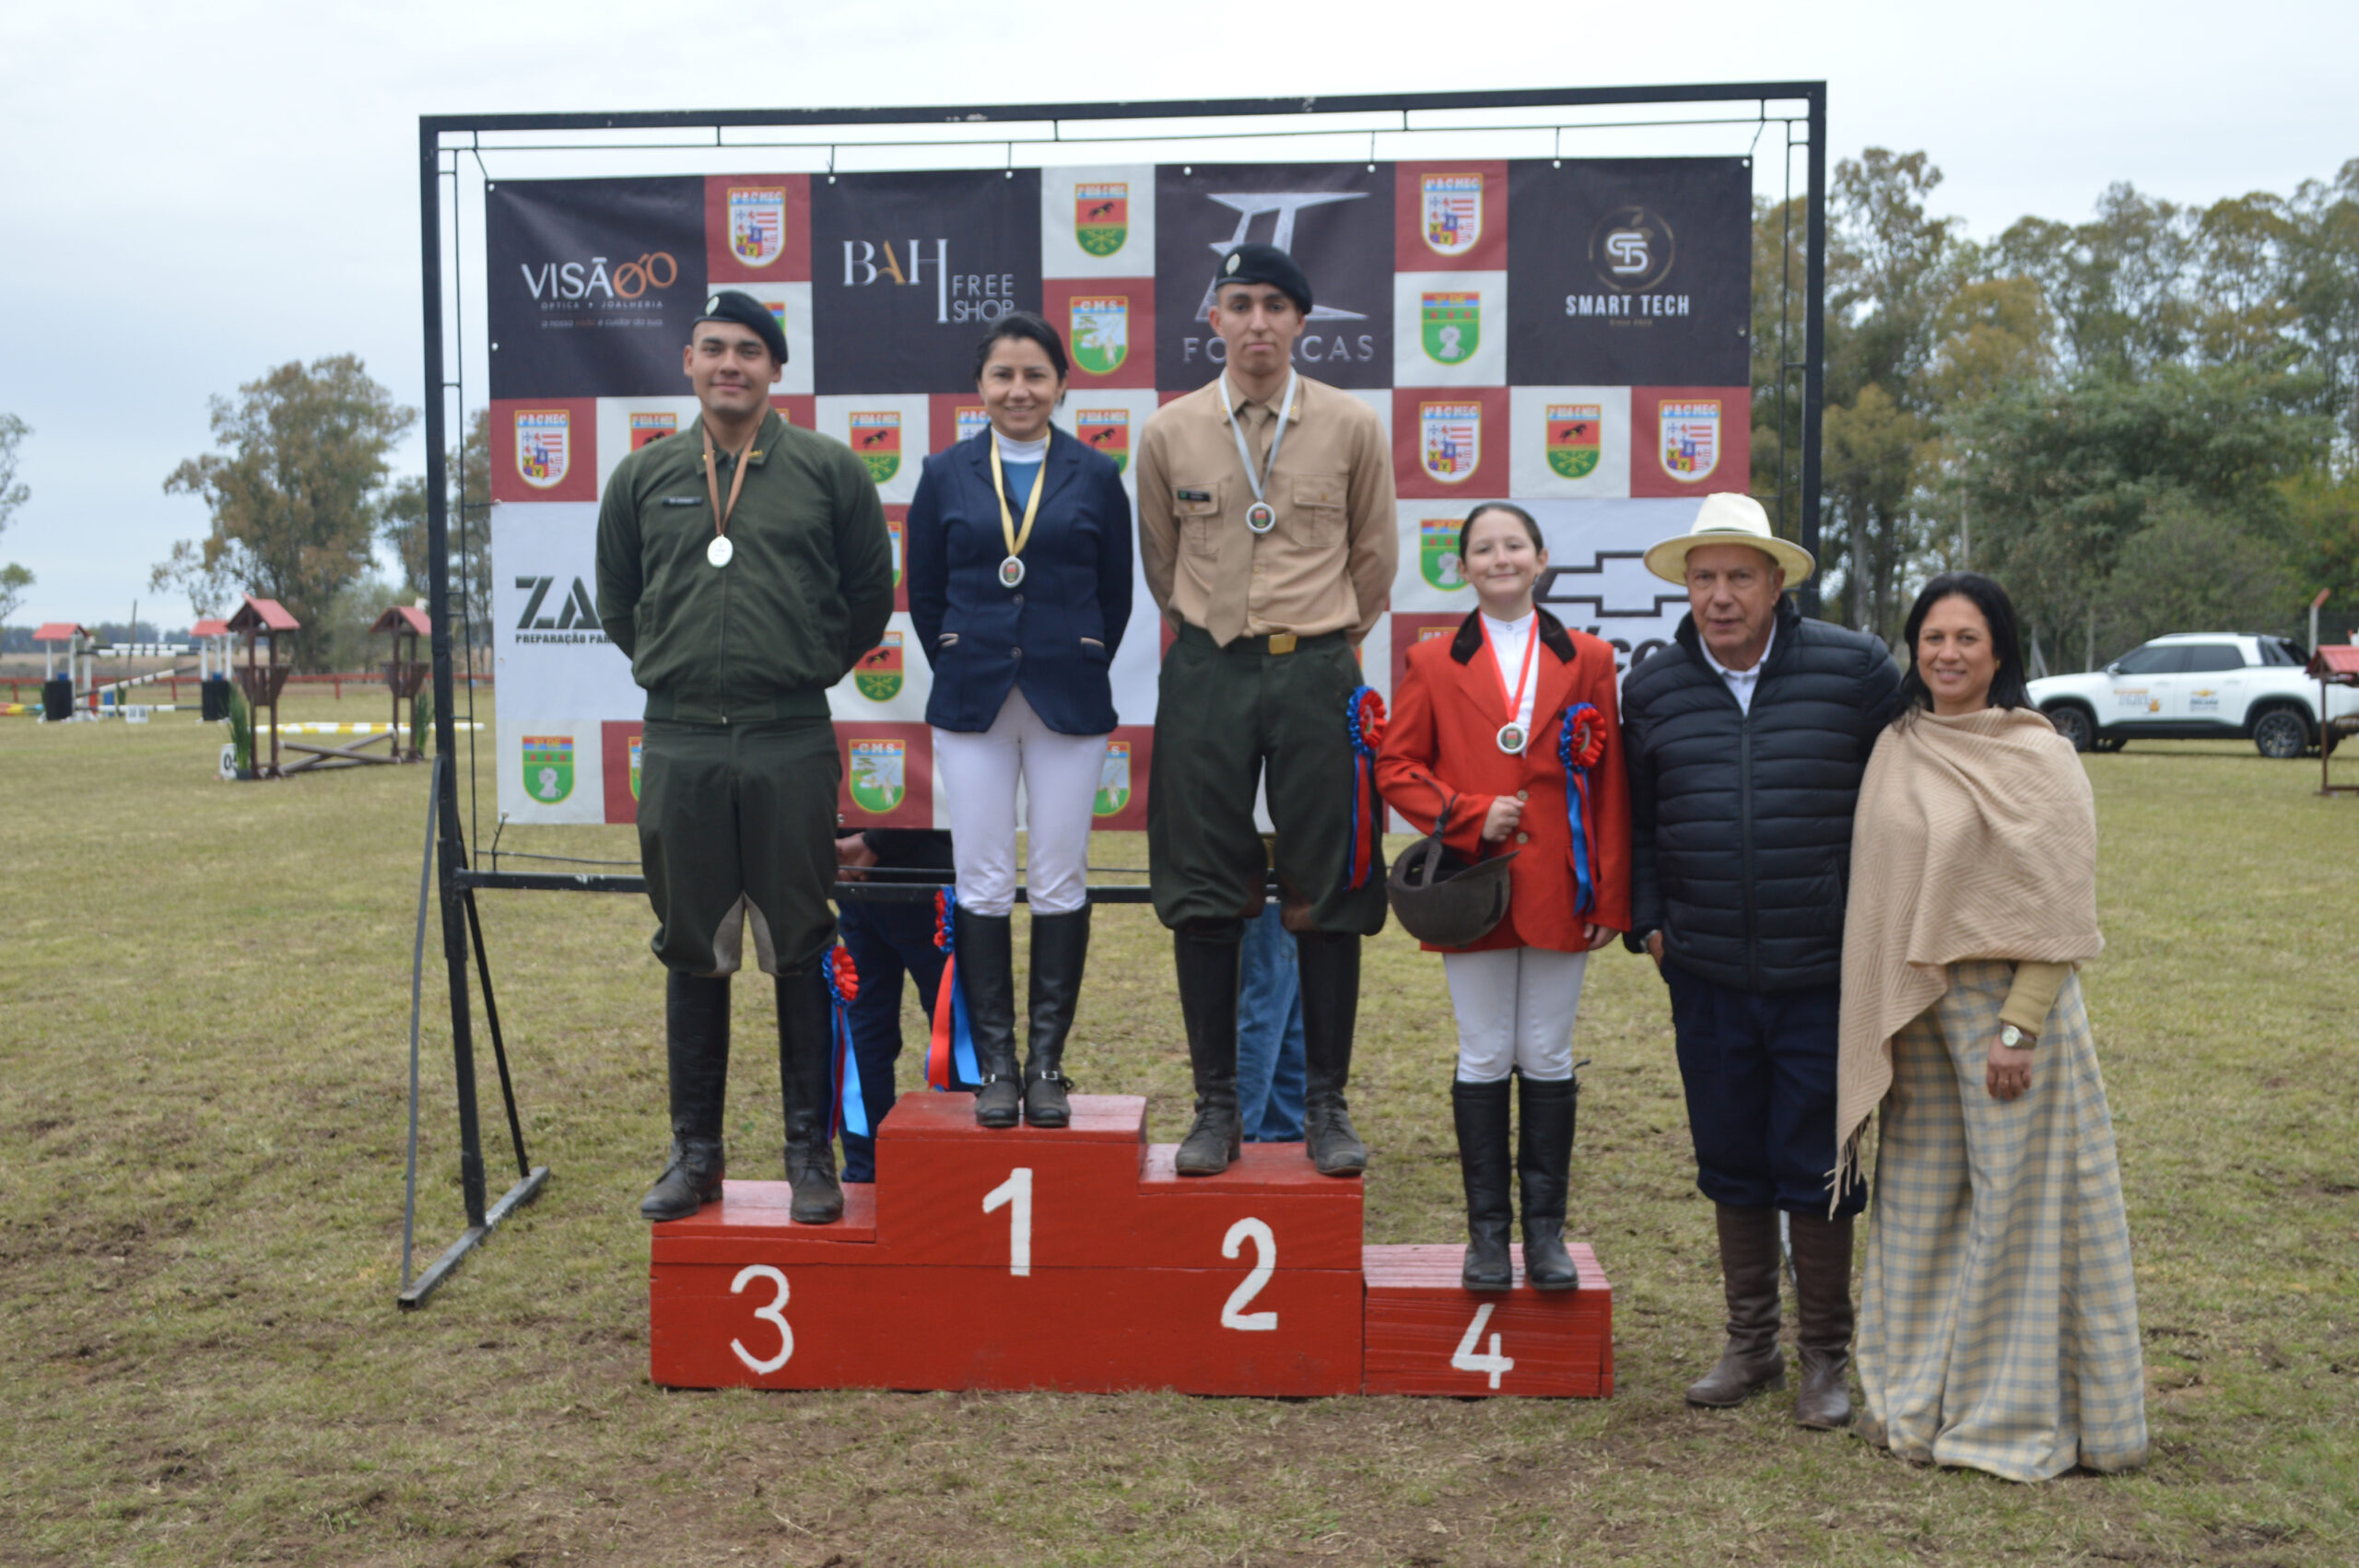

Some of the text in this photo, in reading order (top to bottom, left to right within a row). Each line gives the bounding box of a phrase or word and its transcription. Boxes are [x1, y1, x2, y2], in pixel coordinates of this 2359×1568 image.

[842, 239, 948, 322] BAH
[952, 274, 1014, 297] FREE
[952, 299, 1015, 322] SHOP
[1566, 295, 1689, 316] SMART TECH
[516, 631, 586, 645] PREPARAÇÃO
[983, 1168, 1032, 1276] 1
[1221, 1217, 1277, 1330] 2
[731, 1265, 793, 1375] 3
[1451, 1305, 1513, 1388] 4
